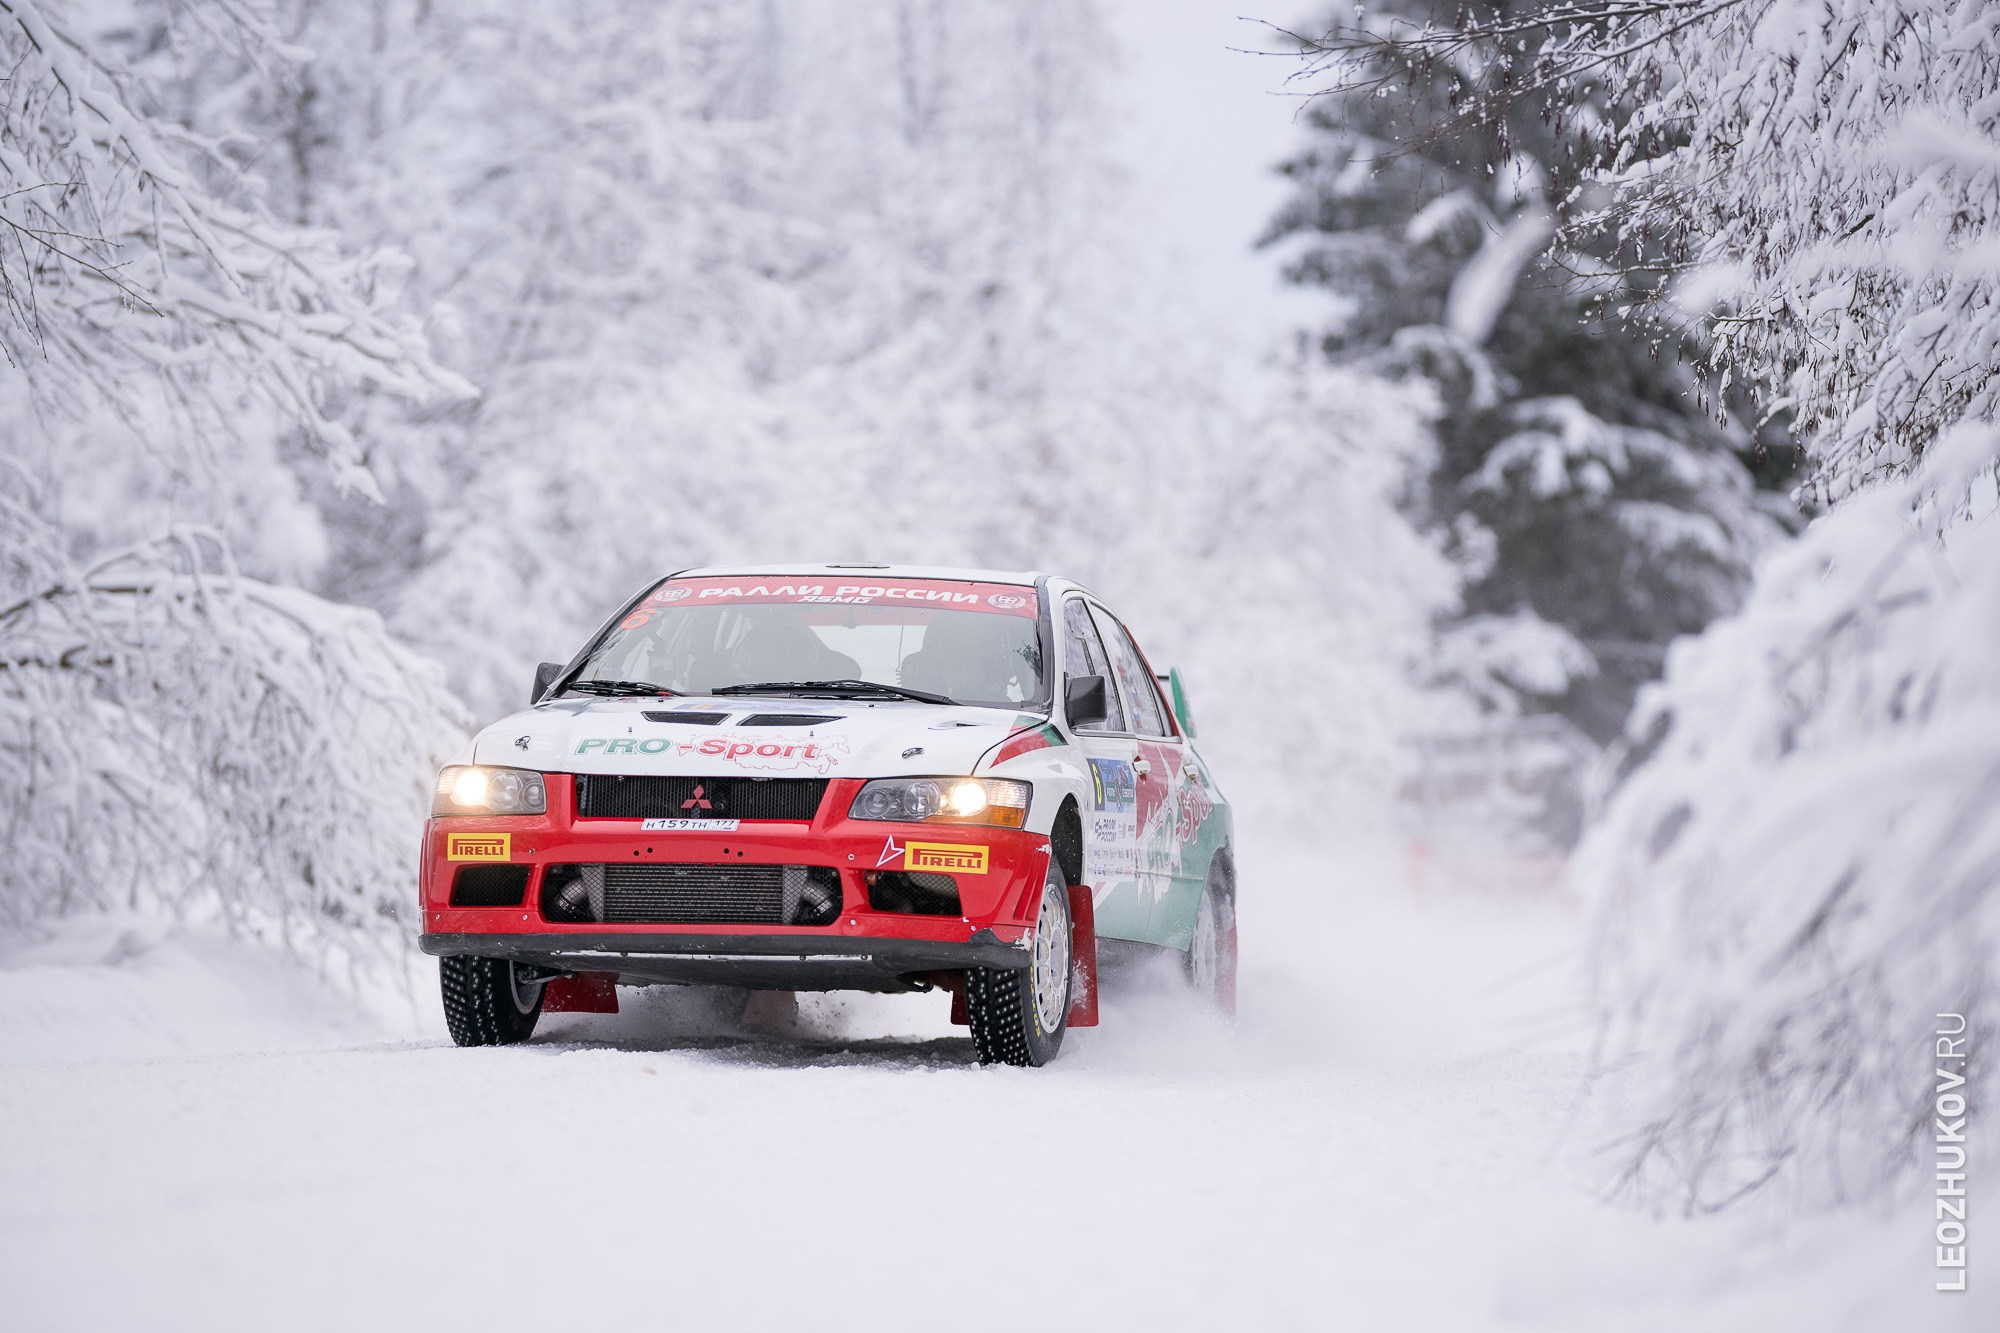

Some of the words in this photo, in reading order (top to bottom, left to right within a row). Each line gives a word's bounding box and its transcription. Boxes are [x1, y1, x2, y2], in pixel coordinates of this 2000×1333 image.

[698, 583, 825, 599] РАЛЛИ
[832, 585, 979, 604] РОССИИ
[620, 608, 657, 630] 6
[1092, 763, 1102, 805] 6
[452, 838, 505, 855] PIRELLI
[912, 848, 983, 869] PIRELLI
